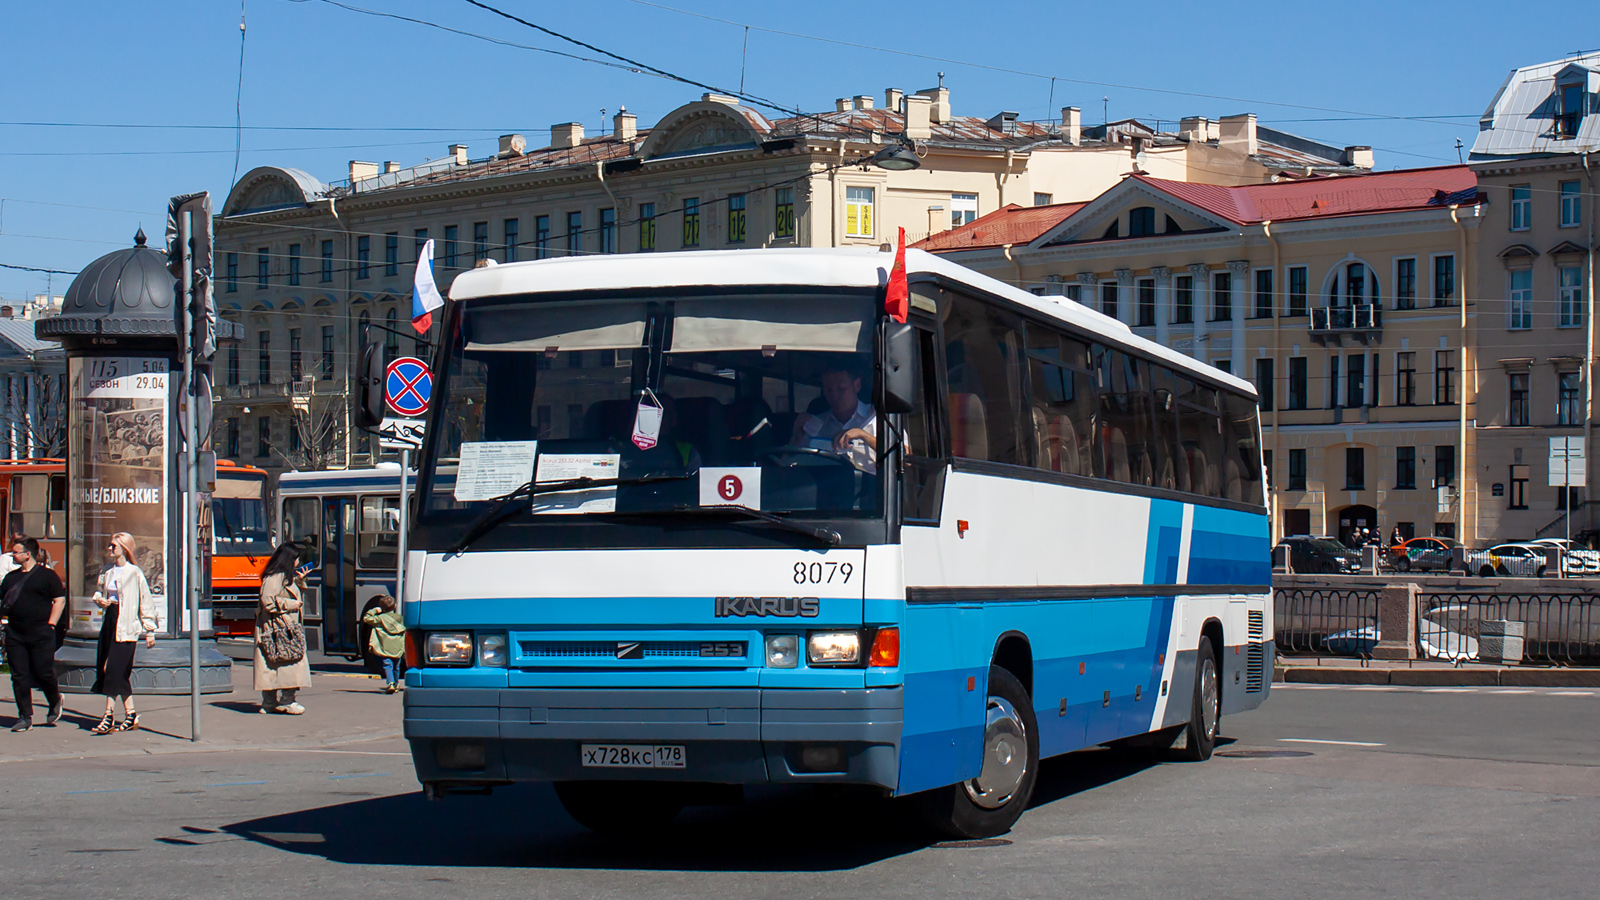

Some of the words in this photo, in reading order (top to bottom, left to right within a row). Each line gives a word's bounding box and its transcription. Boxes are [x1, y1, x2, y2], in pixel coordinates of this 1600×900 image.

[731, 214, 745, 237] 12
[778, 209, 793, 232] 20
[90, 360, 119, 378] 115
[142, 360, 165, 373] 5.04
[89, 379, 119, 389] СЕЗОН
[136, 376, 165, 389] 29.04
[575, 457, 591, 465] Alpha
[725, 479, 735, 497] 5
[793, 561, 853, 585] 8079
[714, 597, 820, 618] IKARUS
[700, 643, 742, 657] 253
[656, 746, 682, 761] 178
